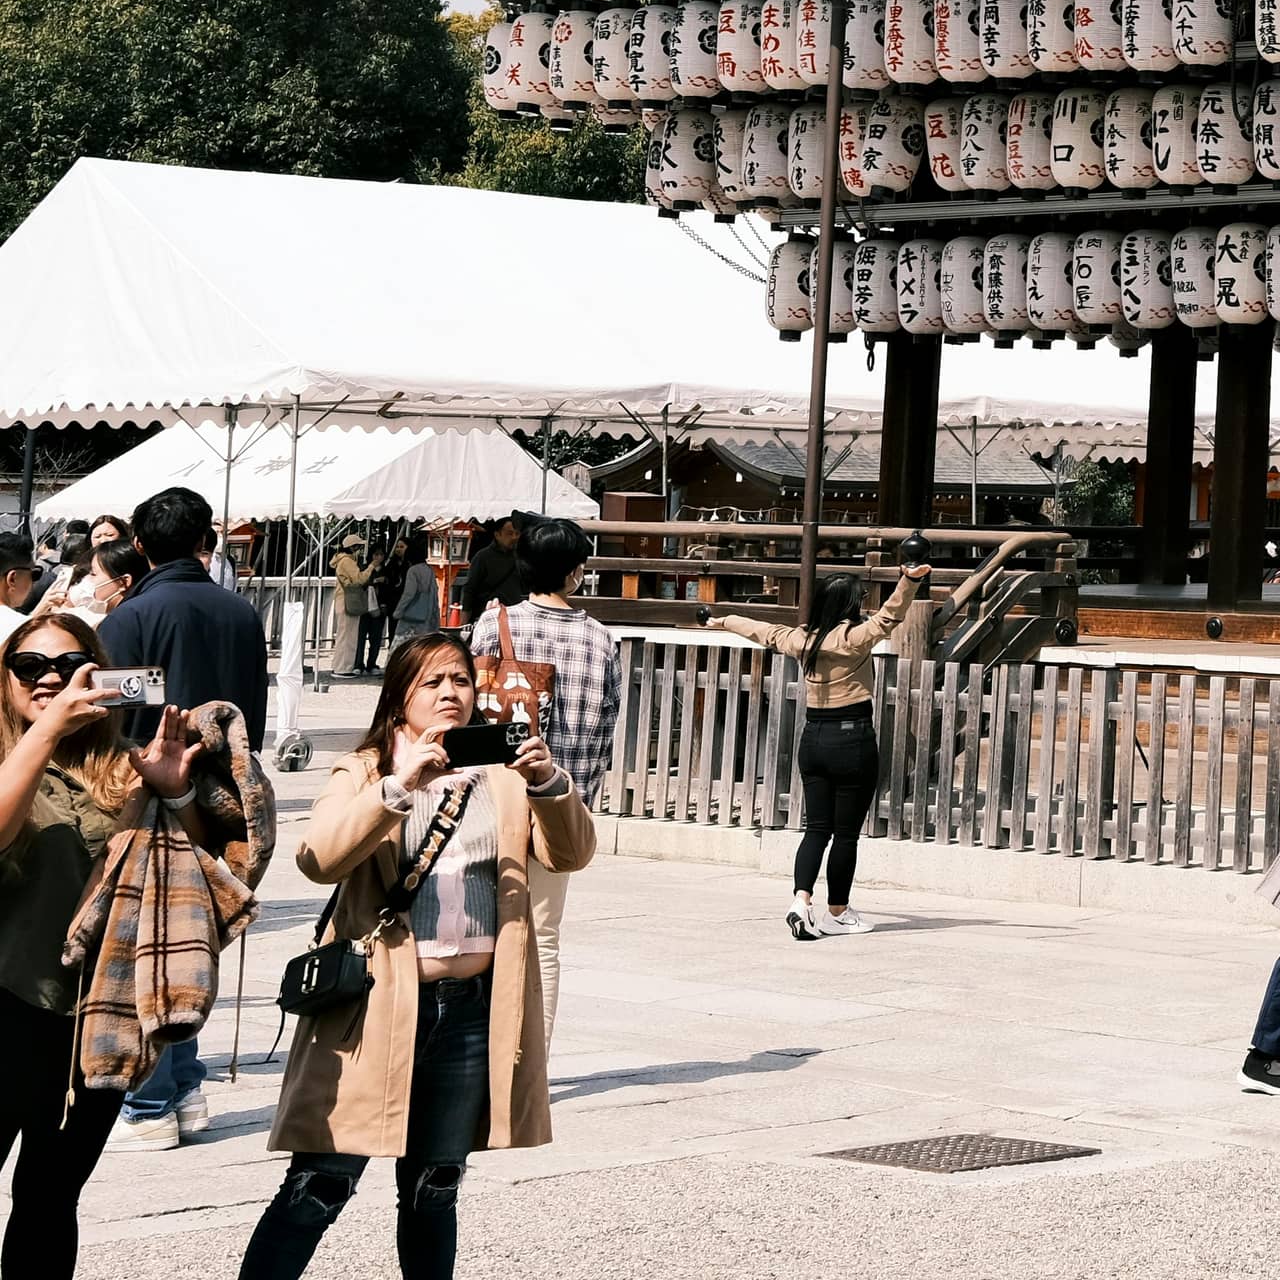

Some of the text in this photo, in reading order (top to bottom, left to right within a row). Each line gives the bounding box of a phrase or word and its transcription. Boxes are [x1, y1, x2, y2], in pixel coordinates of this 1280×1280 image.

[862, 99, 889, 172] 池田家
[1053, 97, 1078, 163] 川口
[1199, 90, 1225, 175] 元奈古
[1123, 236, 1141, 322] ミュンヘン
[1216, 234, 1243, 308] 大晃
[1239, 231, 1250, 260] 株式会社
[900, 248, 919, 324] キメラ
